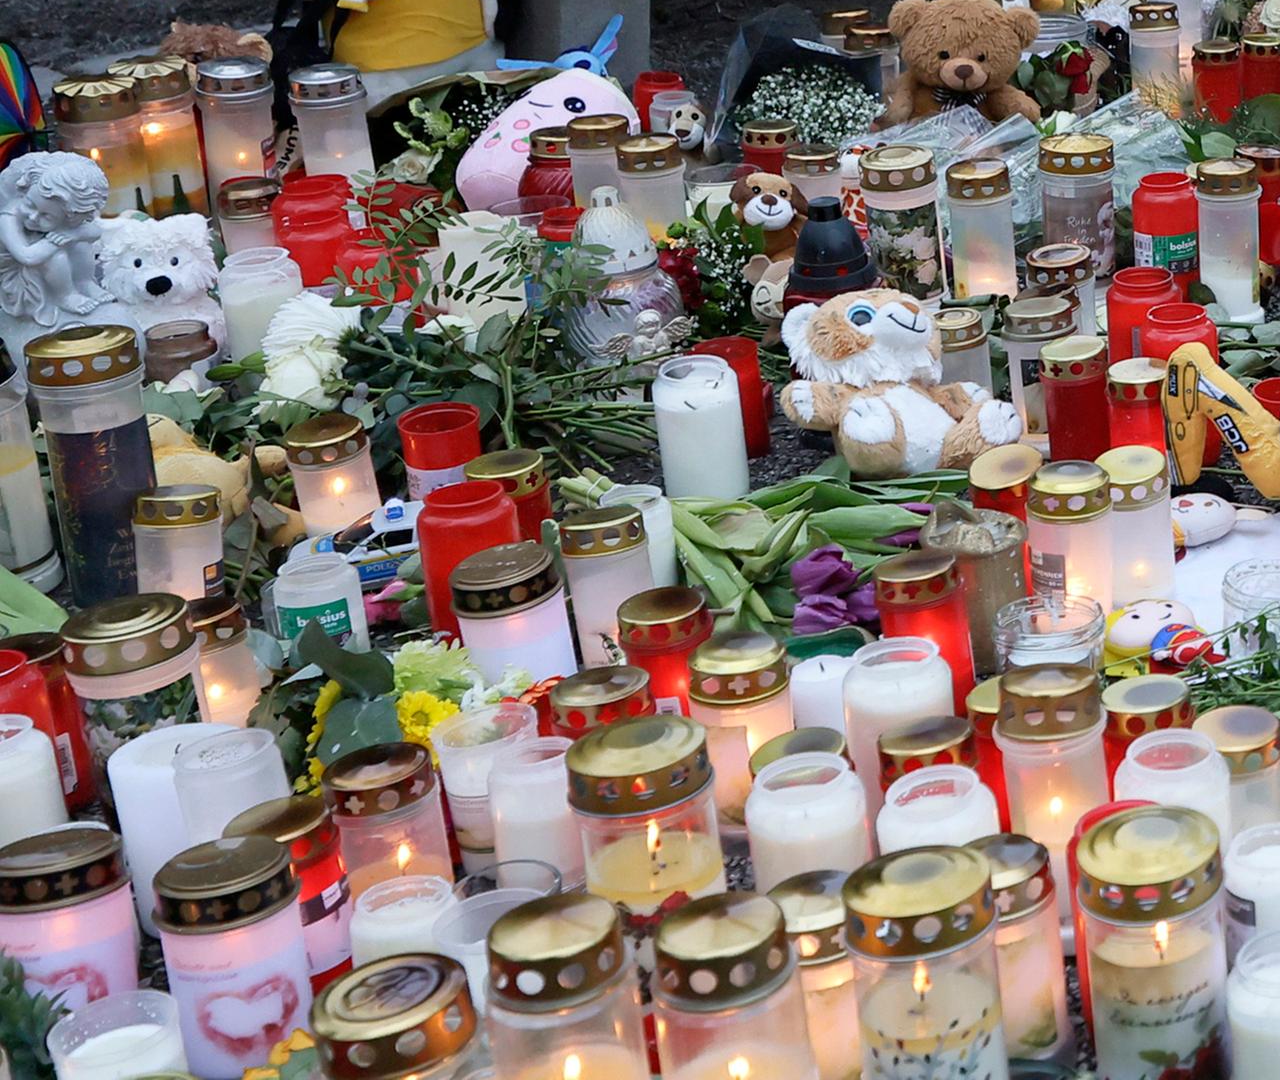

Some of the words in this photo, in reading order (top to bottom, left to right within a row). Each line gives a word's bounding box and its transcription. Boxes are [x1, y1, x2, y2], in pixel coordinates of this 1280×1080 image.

[276, 124, 299, 169] LUME
[1067, 216, 1092, 227] Ruhe
[1215, 414, 1248, 453] JCB
[297, 610, 346, 627] bsius
